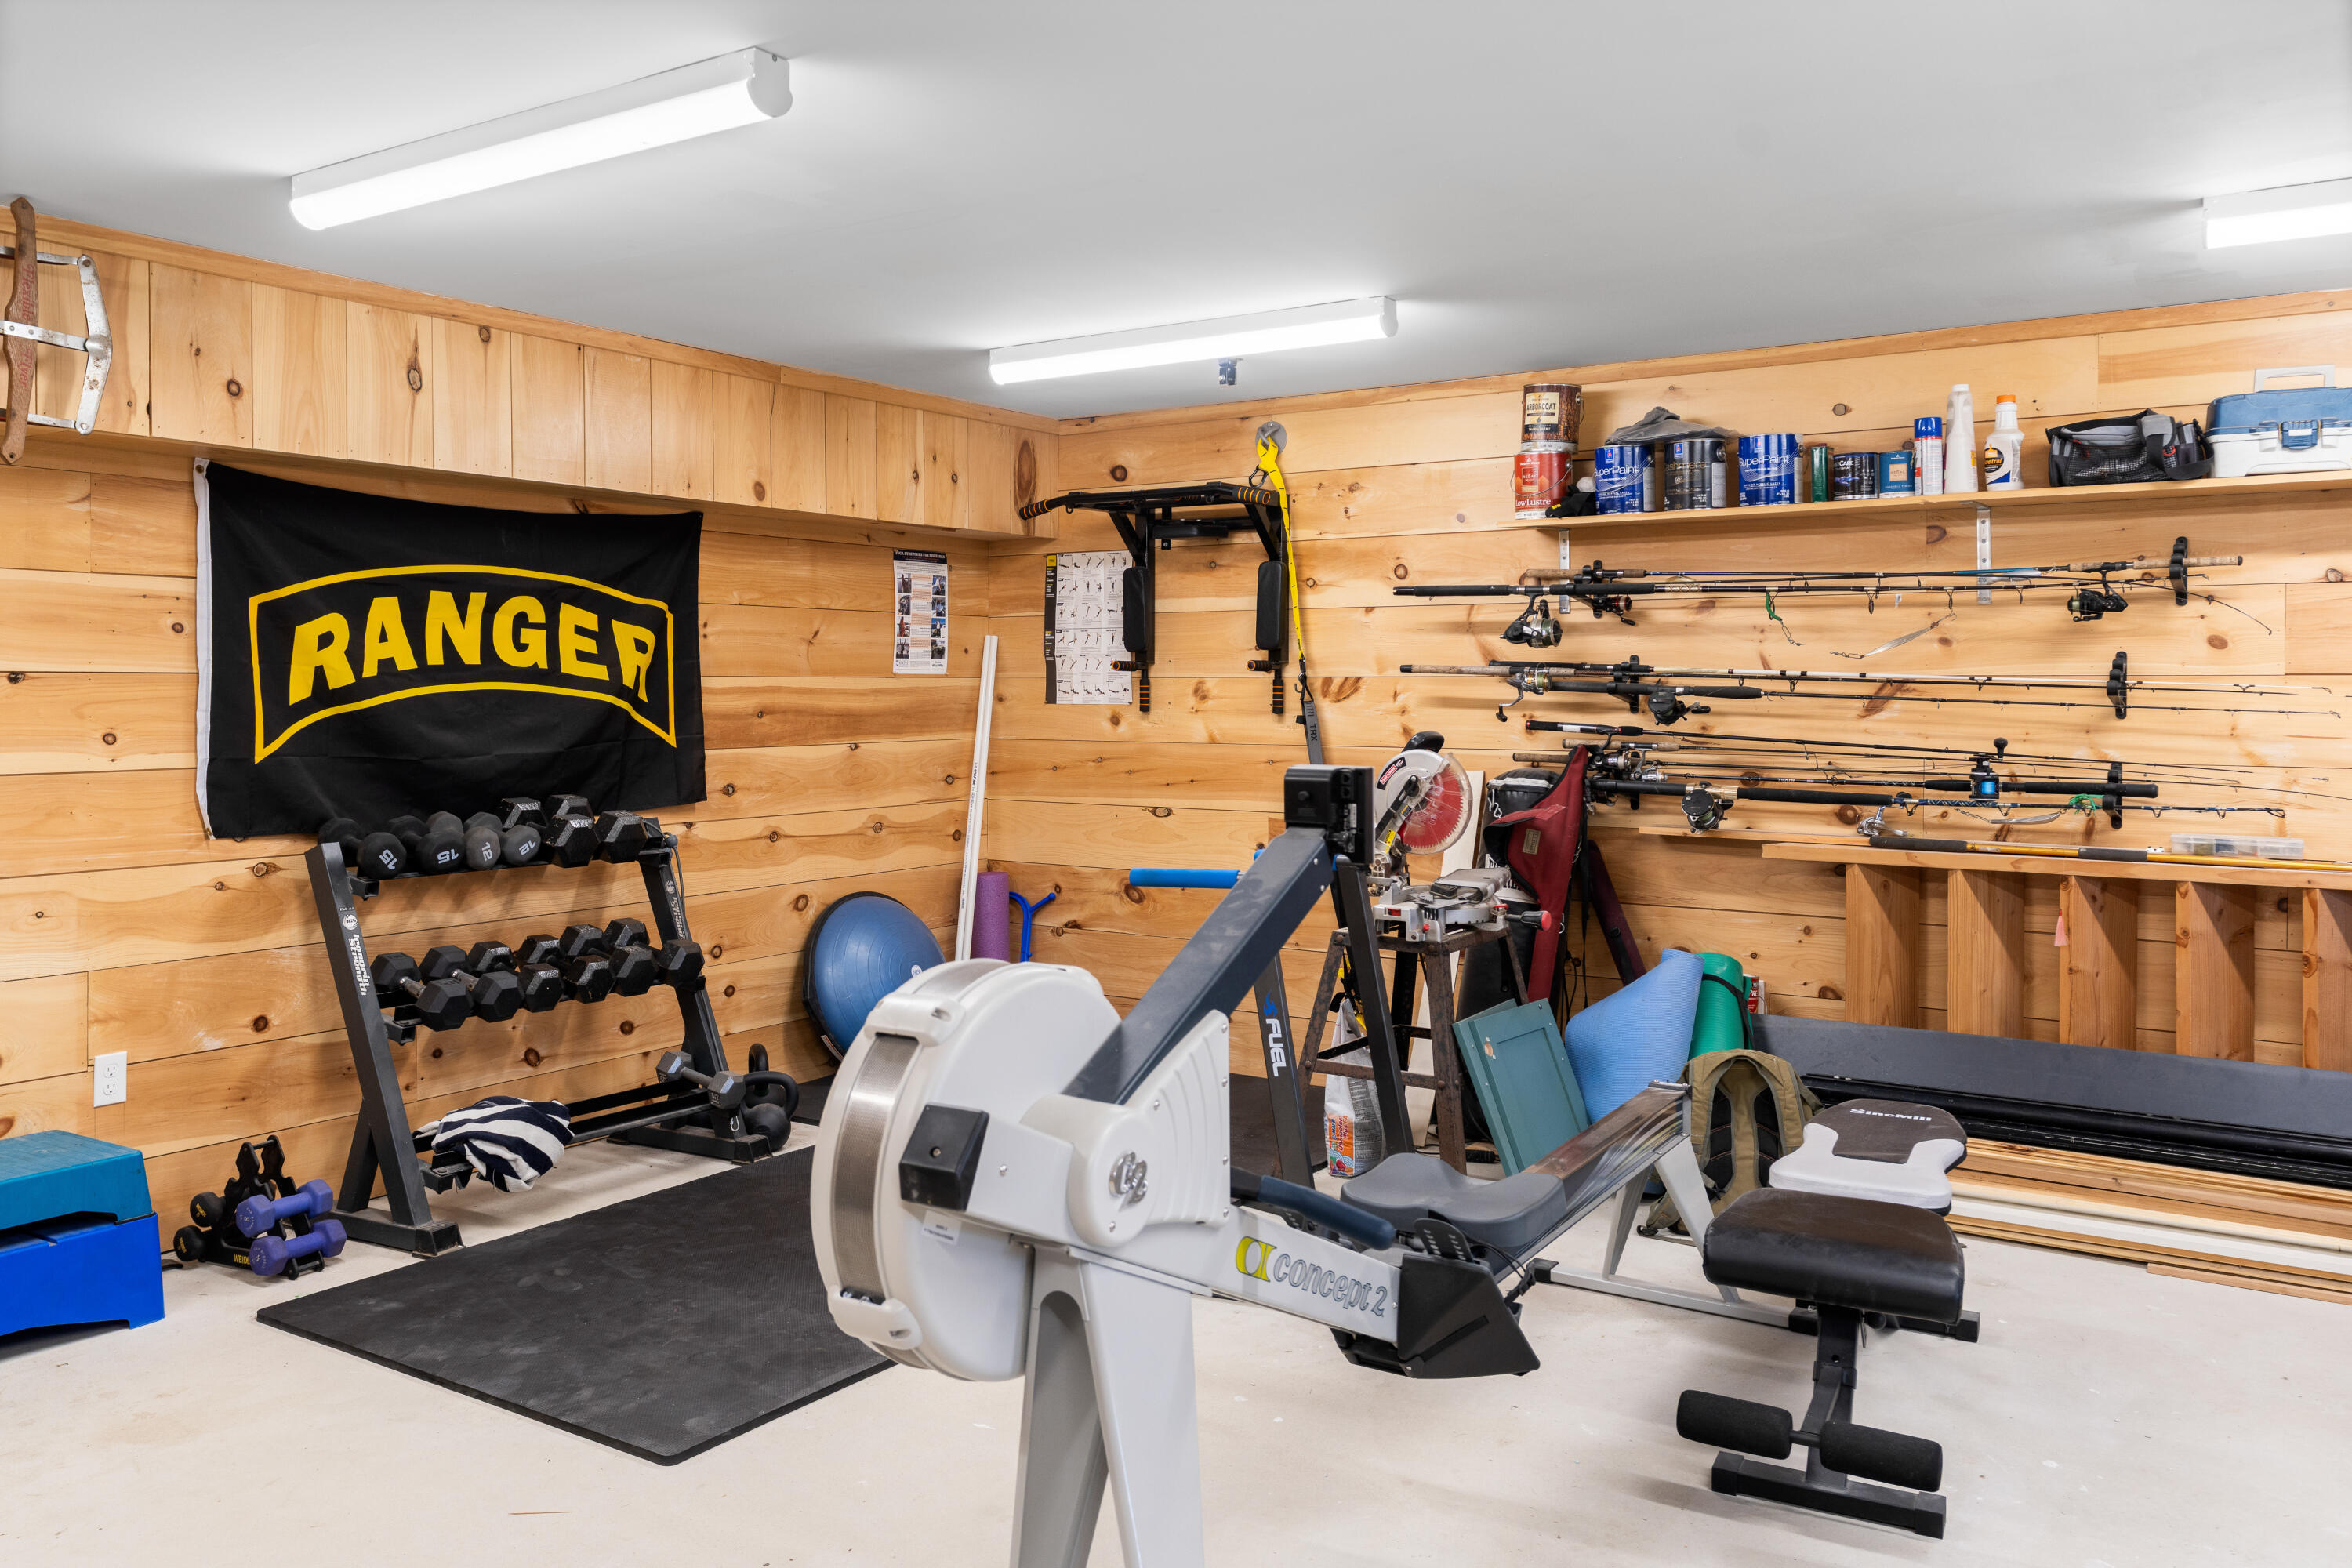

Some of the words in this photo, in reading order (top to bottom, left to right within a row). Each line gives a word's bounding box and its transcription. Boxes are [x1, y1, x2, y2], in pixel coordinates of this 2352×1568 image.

[22, 263, 35, 321] Flexible
[18, 349, 34, 390] Flyer
[1739, 455, 1790, 468] SuperPaint
[289, 590, 656, 706] RANGER
[1309, 724, 1318, 742] TRX
[437, 848, 459, 864] 15
[481, 841, 493, 862] 12
[518, 840, 536, 855] 12
[379, 848, 397, 870] 15
[1265, 1018, 1287, 1077] FUEL
[1272, 1253, 1373, 1312] concept
[1370, 1285, 1388, 1318] 2
